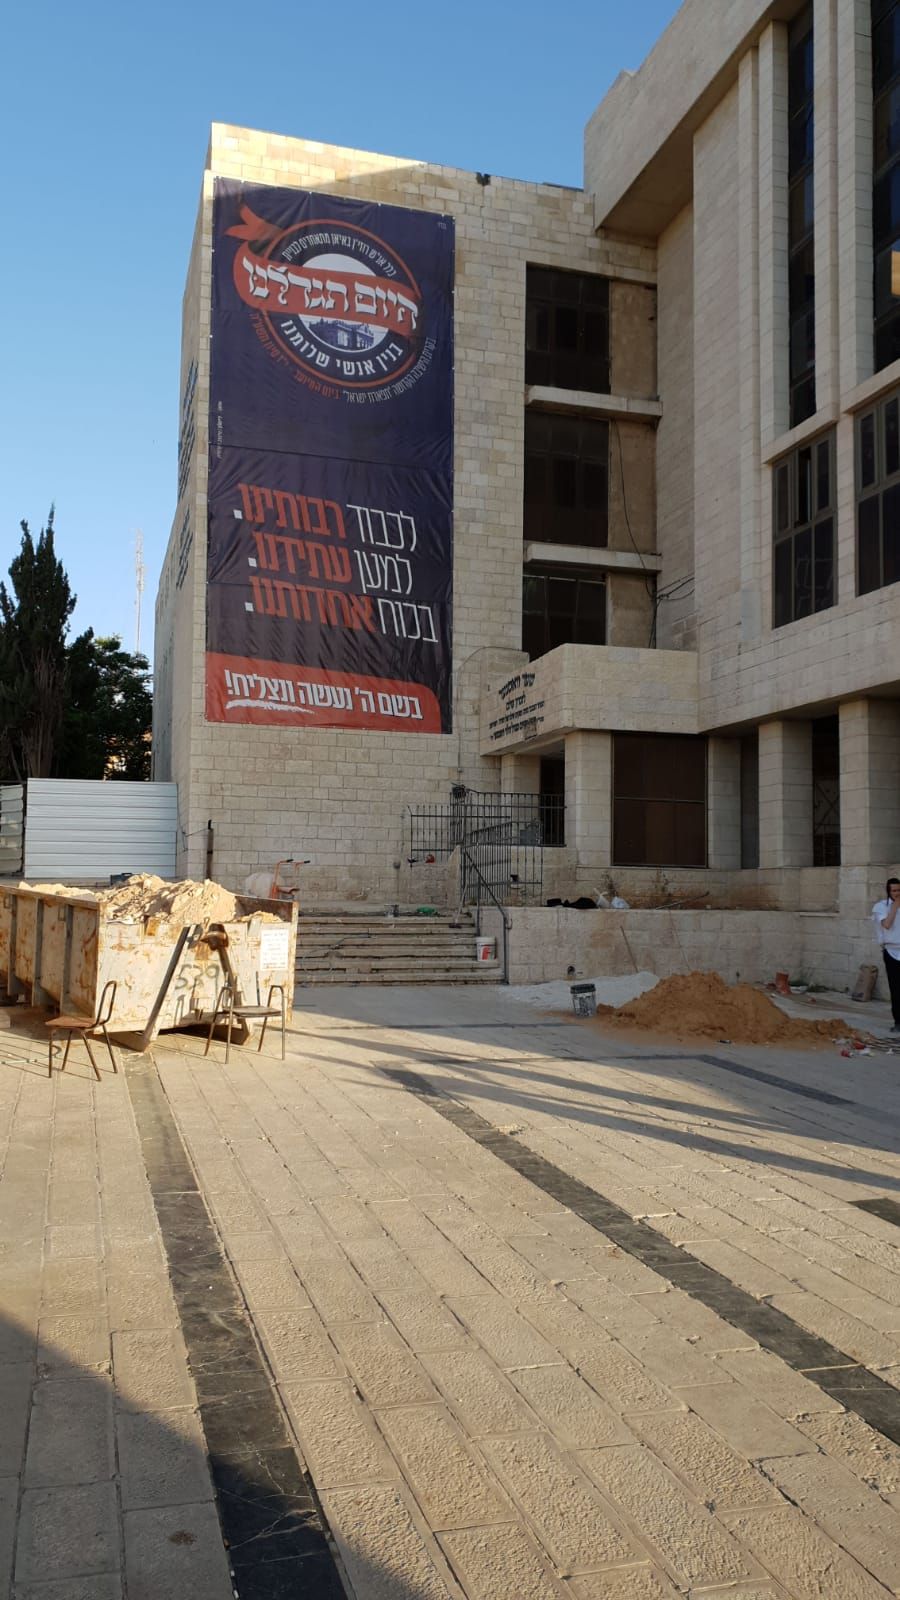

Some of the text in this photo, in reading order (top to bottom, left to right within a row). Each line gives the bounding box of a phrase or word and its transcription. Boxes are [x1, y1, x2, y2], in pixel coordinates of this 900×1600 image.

[354, 281, 419, 330] היום
[280, 319, 404, 376] בנין אנשי שלומנו
[346, 504, 417, 552] לכבוד
[354, 549, 413, 594] למען
[378, 598, 439, 643] בכוח
[224, 669, 423, 720] בשם ה' נעשה ונצליח!
